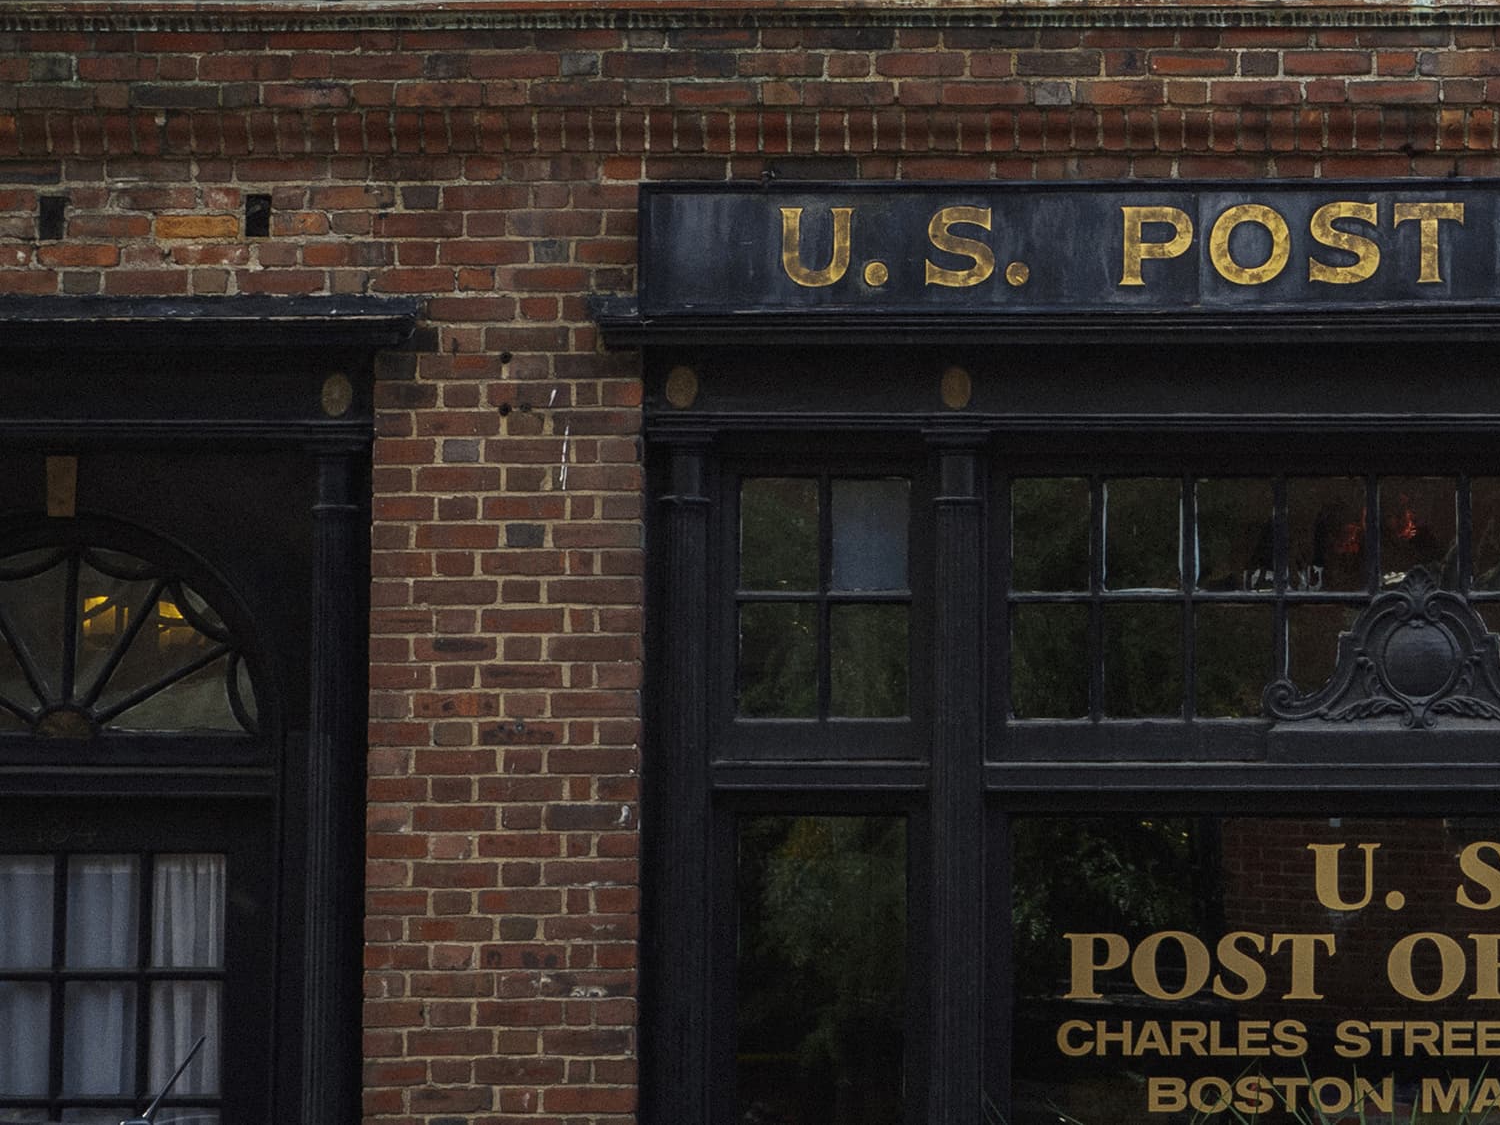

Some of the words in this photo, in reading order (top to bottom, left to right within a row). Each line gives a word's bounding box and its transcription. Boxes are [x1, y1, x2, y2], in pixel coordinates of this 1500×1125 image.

[780, 207, 889, 288] U.
[925, 205, 1030, 287] S.
[1119, 202, 1465, 286] POST
[1306, 842, 1406, 911] U.
[1062, 931, 1337, 1001] POST
[1057, 1019, 1308, 1057] CHARLES
[1148, 1076, 1394, 1114] BOSTON
